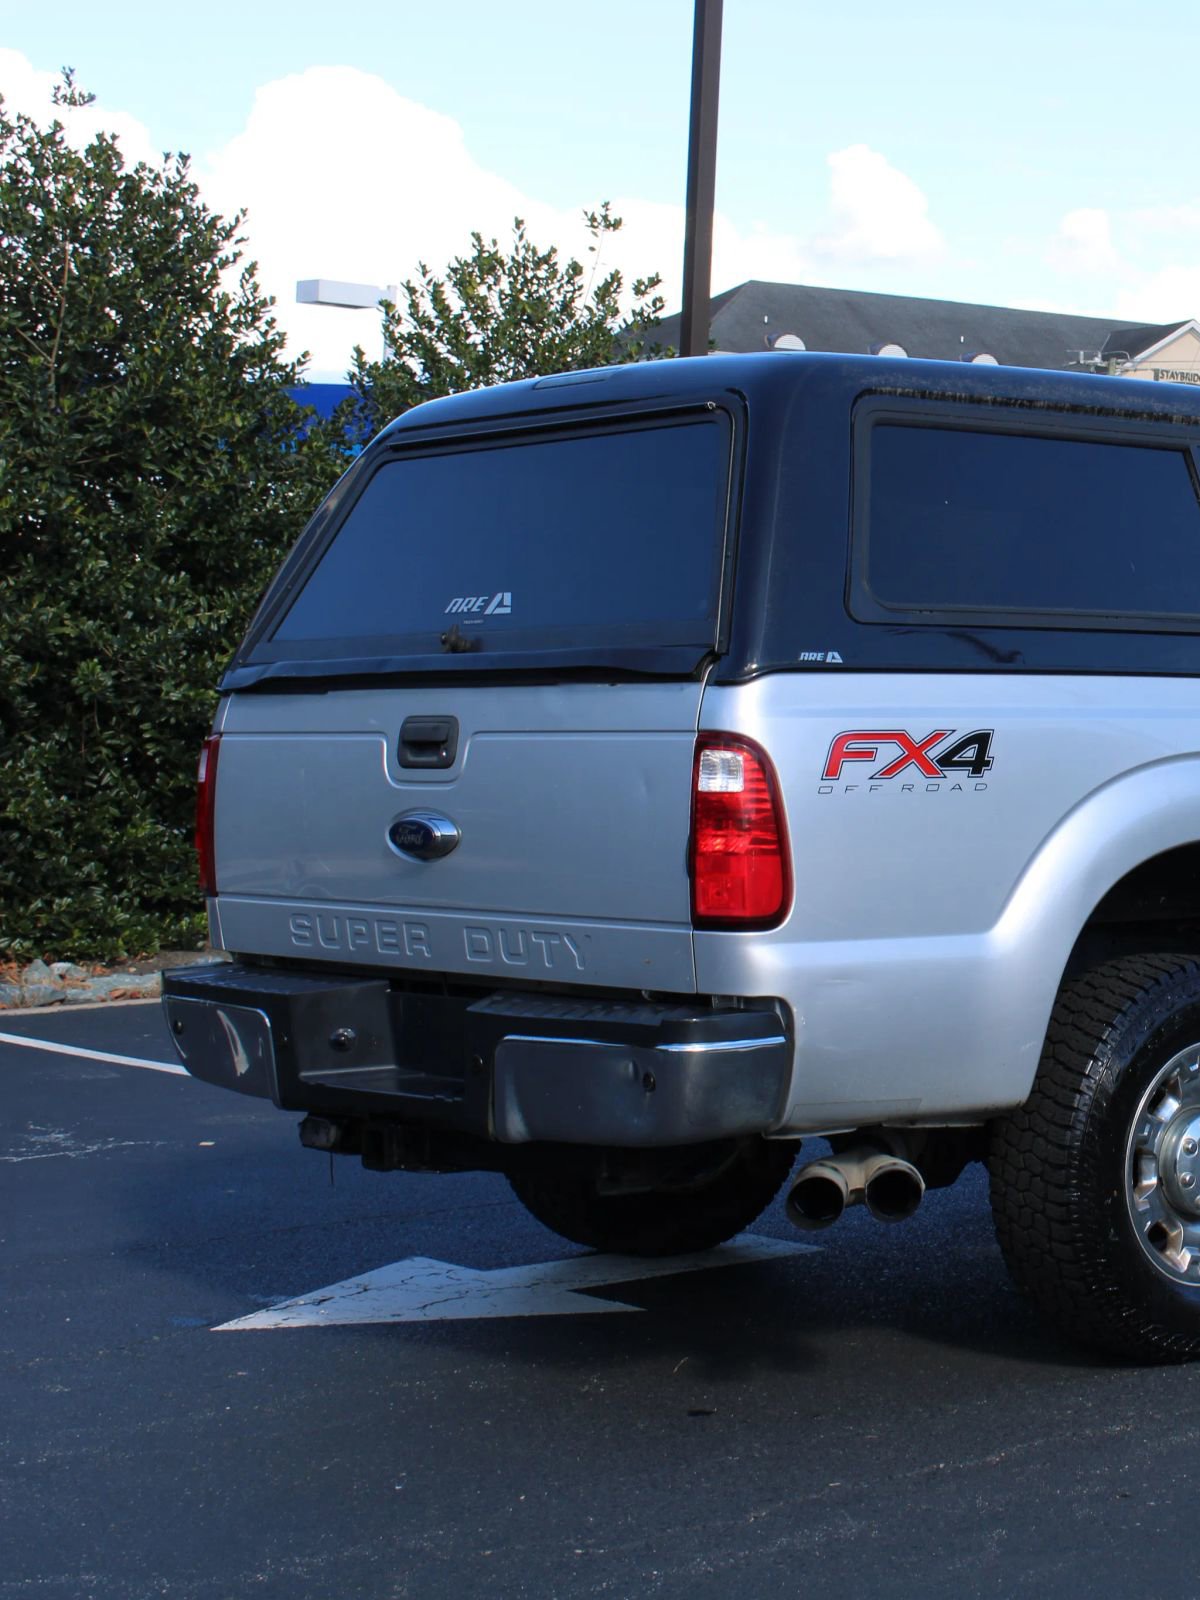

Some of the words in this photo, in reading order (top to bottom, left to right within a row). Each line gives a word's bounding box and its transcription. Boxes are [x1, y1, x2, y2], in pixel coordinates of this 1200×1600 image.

[444, 596, 489, 614] ARE
[800, 652, 825, 661] ARE
[821, 729, 995, 780] FX4
[817, 784, 884, 795] OFF
[901, 782, 988, 793] ROAD
[289, 912, 432, 958] SUPER
[463, 926, 592, 970] DUTY
